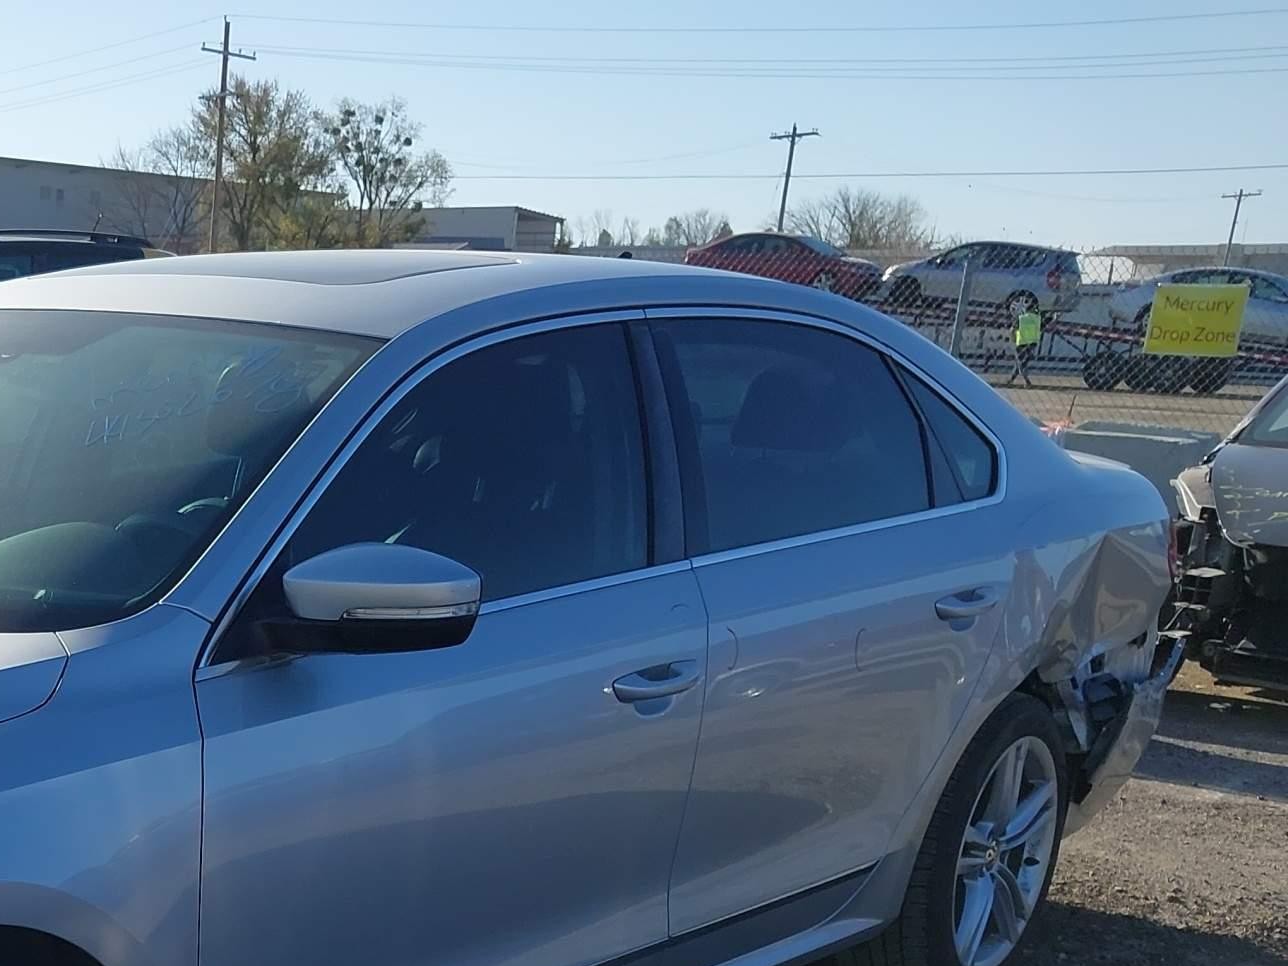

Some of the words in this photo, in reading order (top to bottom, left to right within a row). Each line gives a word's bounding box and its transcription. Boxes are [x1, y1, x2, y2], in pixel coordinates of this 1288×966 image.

[1164, 296, 1234, 313] Mercury
[1150, 325, 1191, 344] Drop
[1193, 326, 1236, 343] Zone
